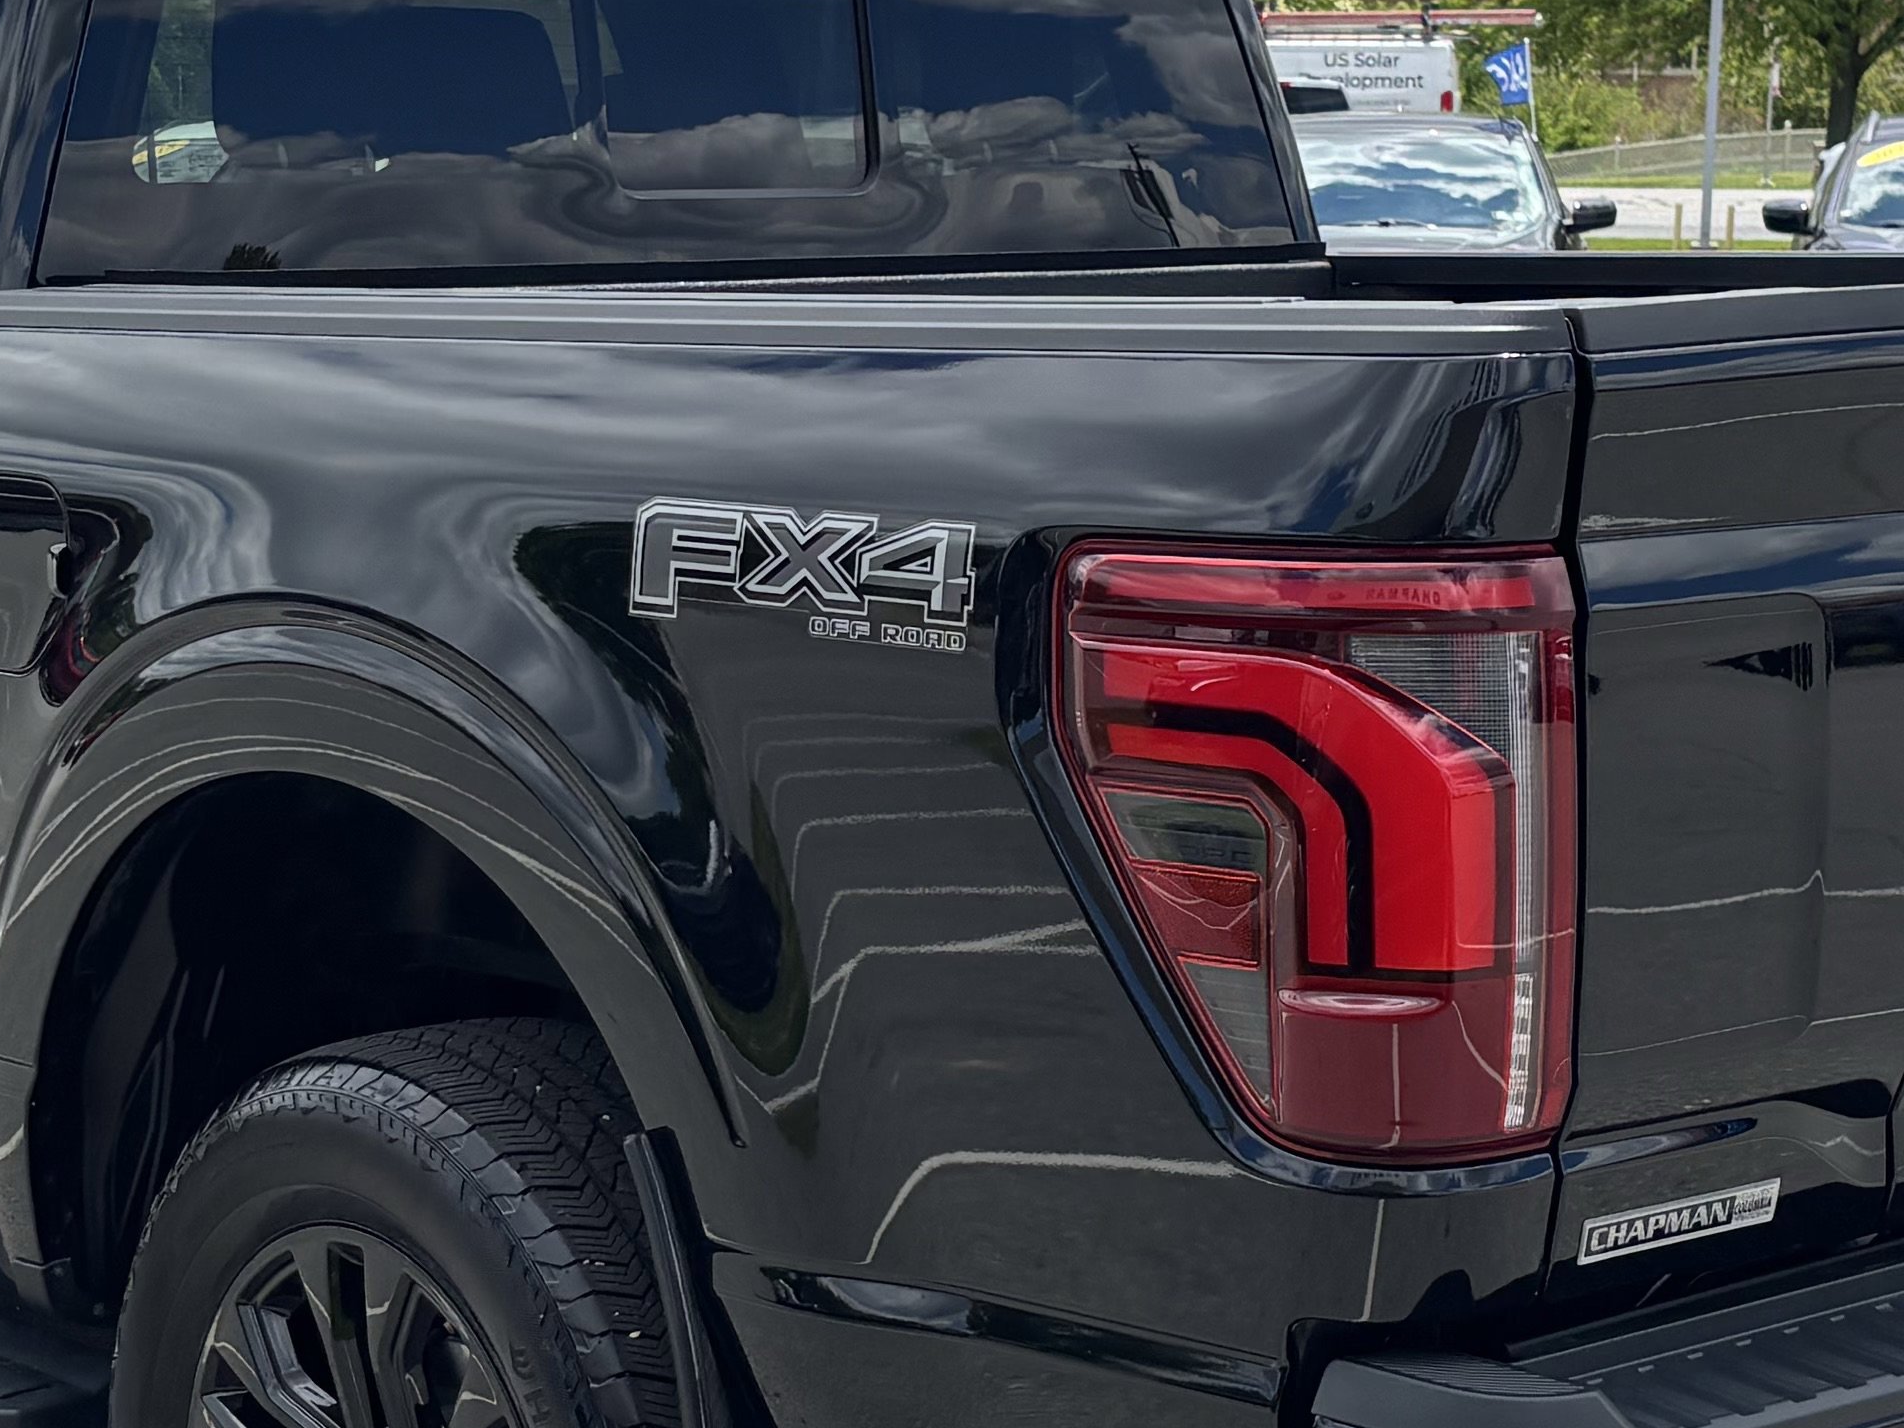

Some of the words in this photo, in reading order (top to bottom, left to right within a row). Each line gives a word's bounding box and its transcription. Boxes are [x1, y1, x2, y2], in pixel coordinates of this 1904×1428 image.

[1324, 53, 1349, 67] US
[1354, 52, 1400, 67] Solar
[629, 496, 977, 625] FX4
[809, 616, 871, 638] OFF
[881, 623, 967, 651] ROAD
[1590, 1199, 1731, 1252] CHAPMAN
